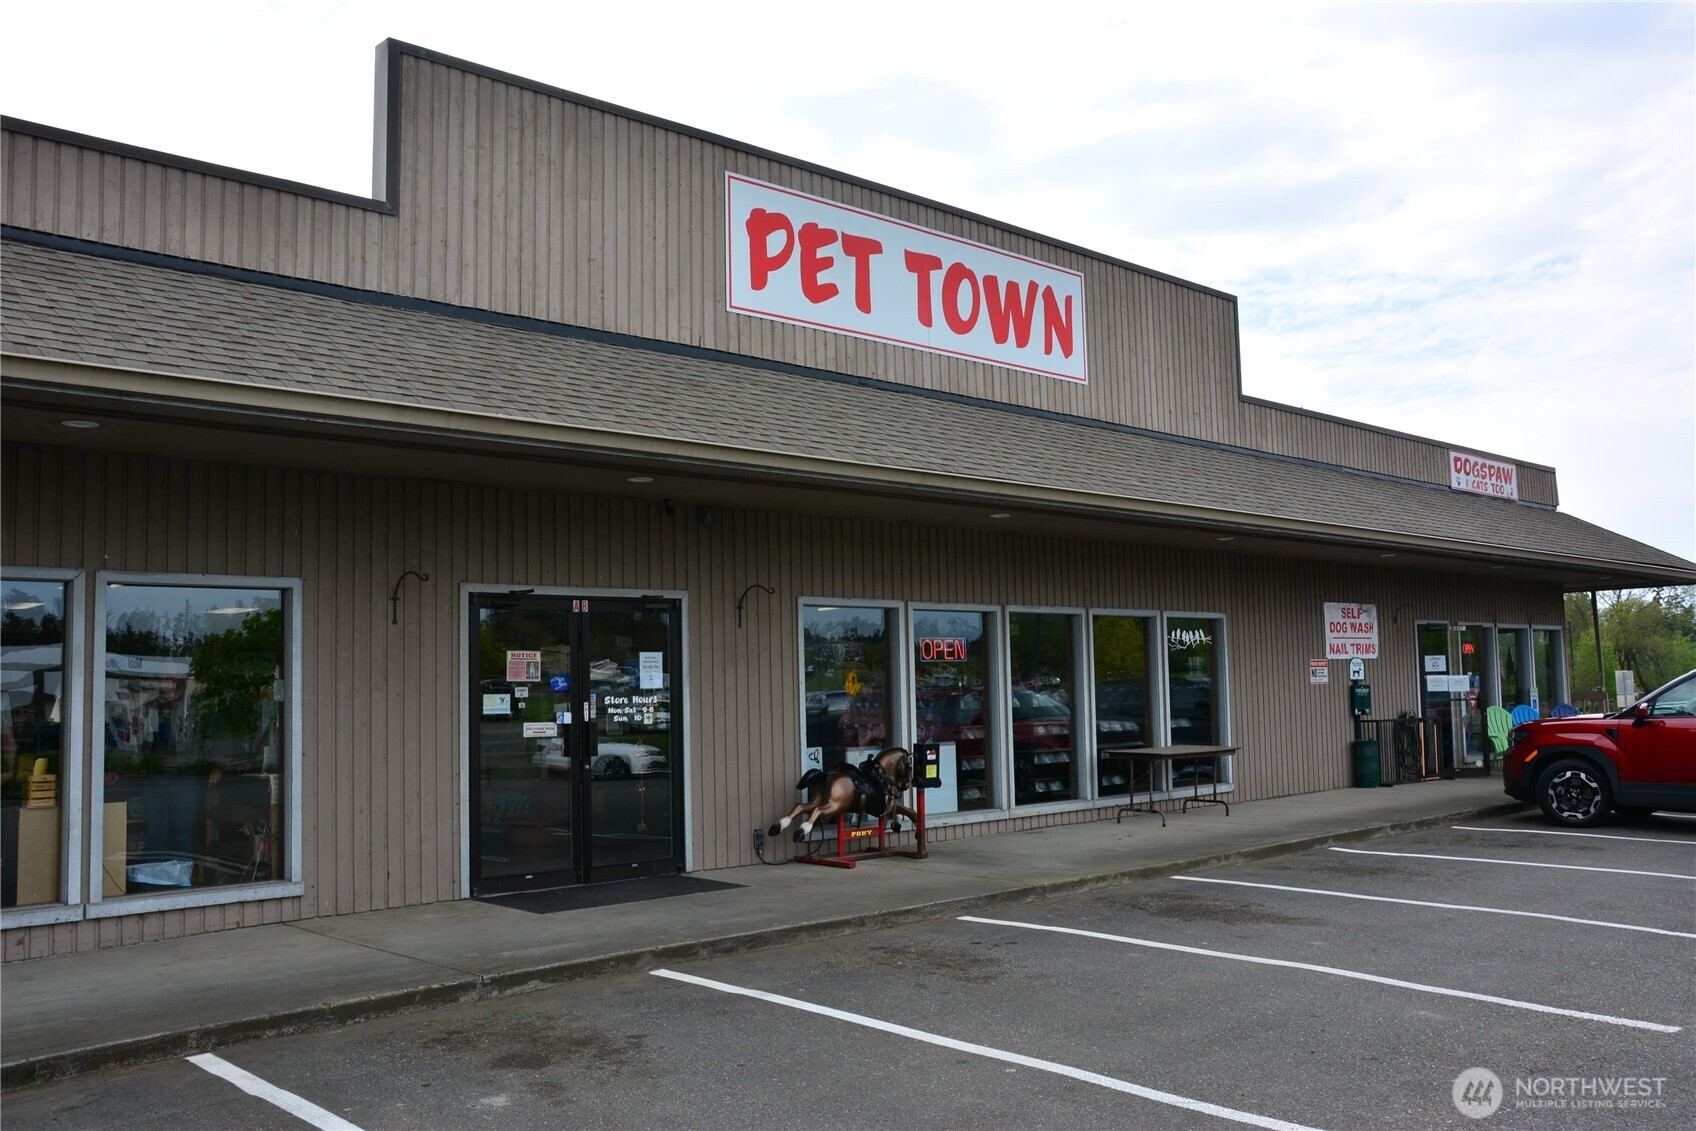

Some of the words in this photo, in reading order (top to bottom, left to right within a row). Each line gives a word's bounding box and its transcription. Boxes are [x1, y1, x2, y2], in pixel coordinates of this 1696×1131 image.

[745, 207, 883, 315] PET
[904, 248, 1073, 359] TOWN
[1453, 455, 1514, 485] DOGSPAW
[1472, 480, 1488, 492] CATS
[1491, 483, 1504, 495] TOO
[574, 601, 579, 611] A
[582, 601, 587, 611] B
[1341, 607, 1363, 619] SELF
[1329, 621, 1347, 633] DOG
[1349, 622, 1374, 634] WASH
[922, 639, 965, 660] OPEN
[1329, 643, 1349, 655] NAIL
[1350, 643, 1376, 655] TRIMS
[1462, 643, 1475, 655] OPEN
[604, 695, 629, 704] Store
[632, 695, 658, 704] Hours
[608, 706, 637, 714] Mon-Sat
